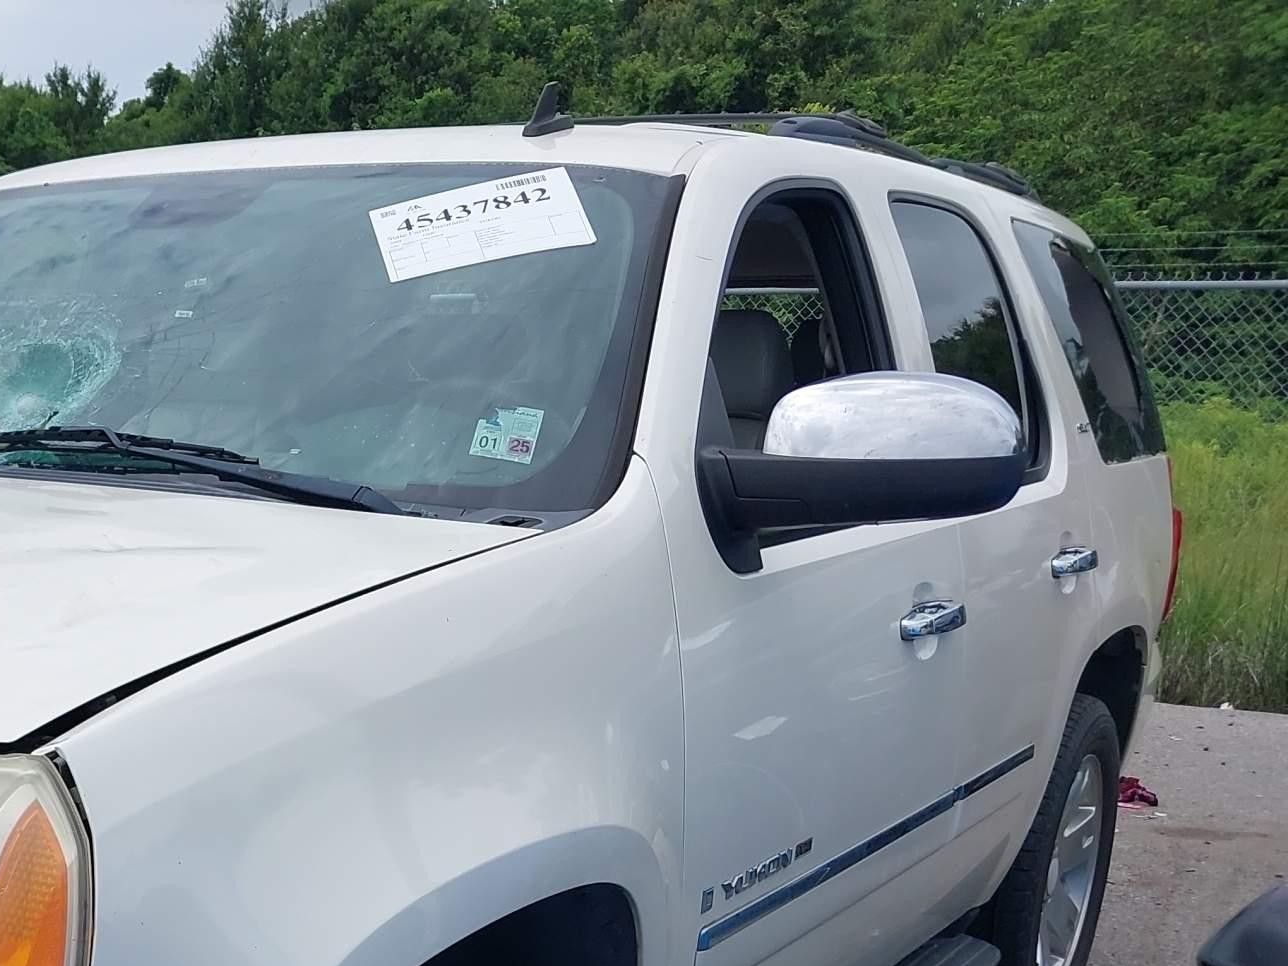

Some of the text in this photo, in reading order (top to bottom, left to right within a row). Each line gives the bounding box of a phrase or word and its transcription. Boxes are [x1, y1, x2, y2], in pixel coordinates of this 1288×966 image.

[396, 187, 551, 232] 45437842
[478, 435, 498, 449] 01
[509, 439, 530, 453] 25
[721, 847, 793, 900] YUKON
